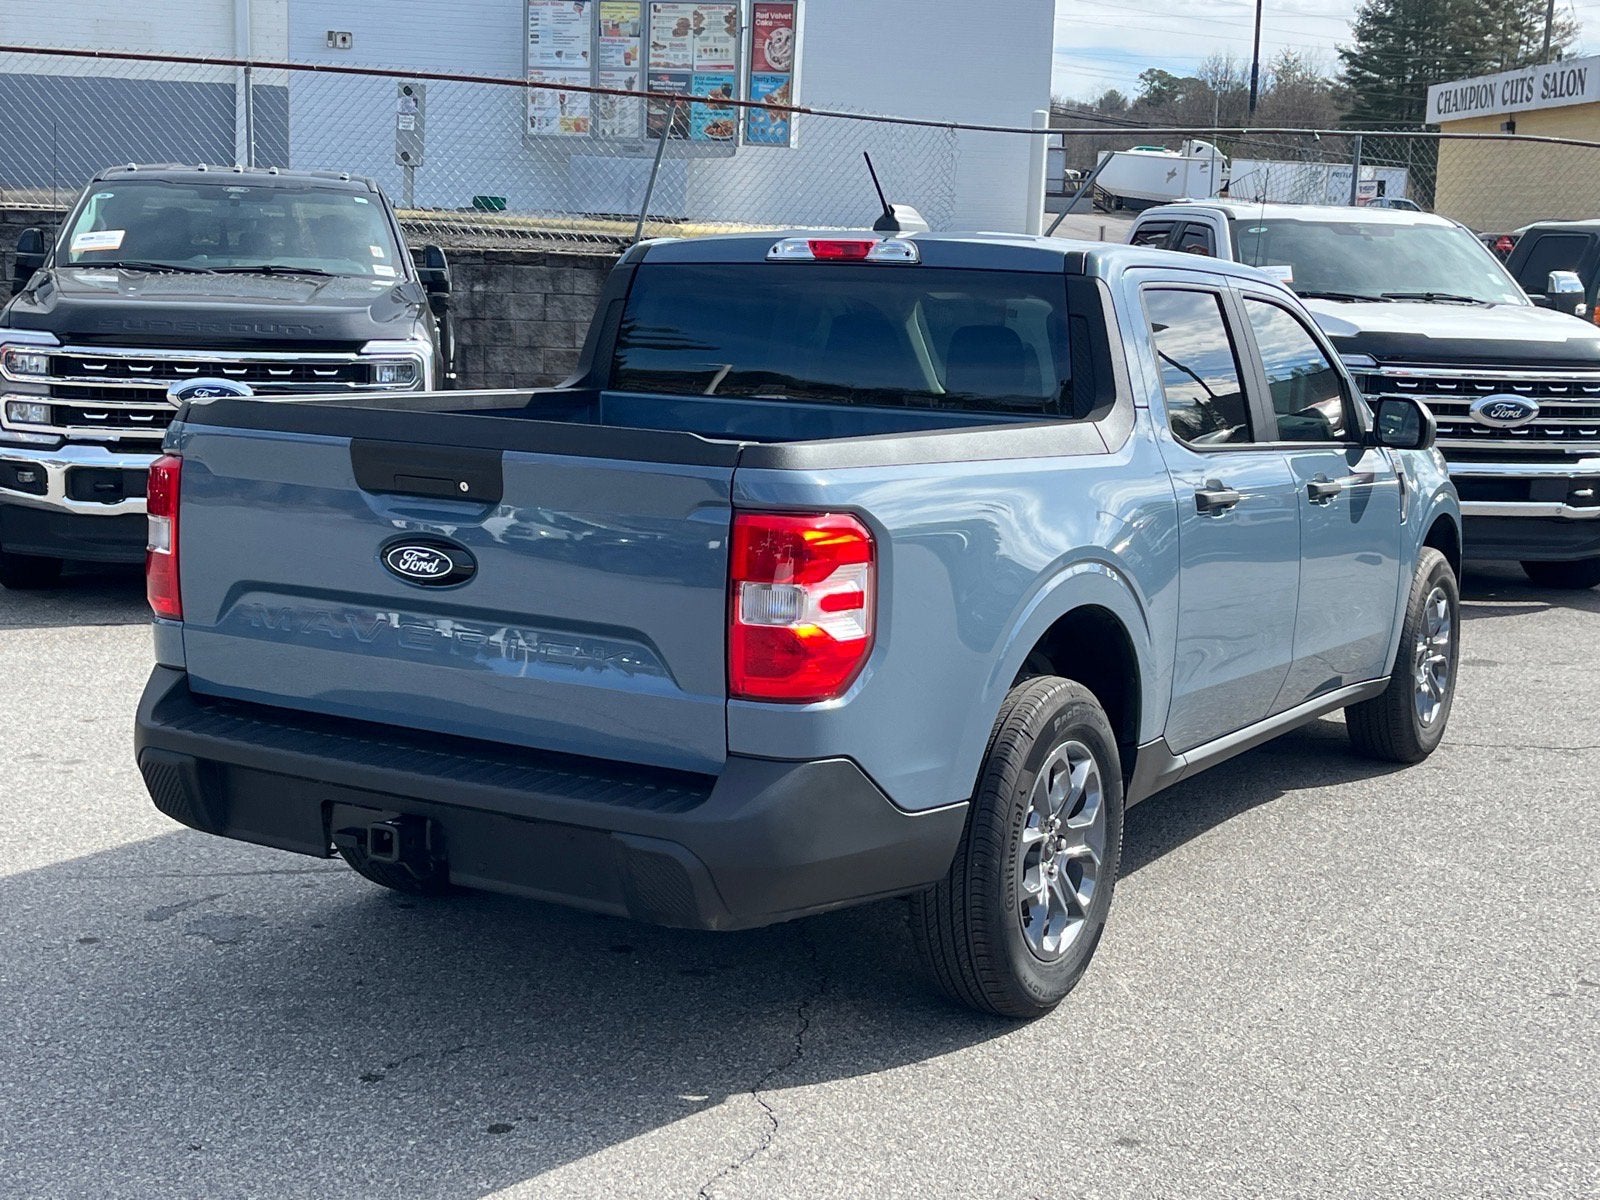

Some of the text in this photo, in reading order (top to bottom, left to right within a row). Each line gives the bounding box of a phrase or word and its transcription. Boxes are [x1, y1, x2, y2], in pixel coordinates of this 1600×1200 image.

[770, 12, 792, 20] Velvet
[1437, 68, 1587, 115] CHAMPION CUTS SALON
[228, 322, 324, 336] DUTY
[1490, 403, 1523, 419] Ford
[399, 550, 440, 573] Ford
[248, 602, 637, 677] MAVERICK
[1005, 802, 1024, 913] Continental
